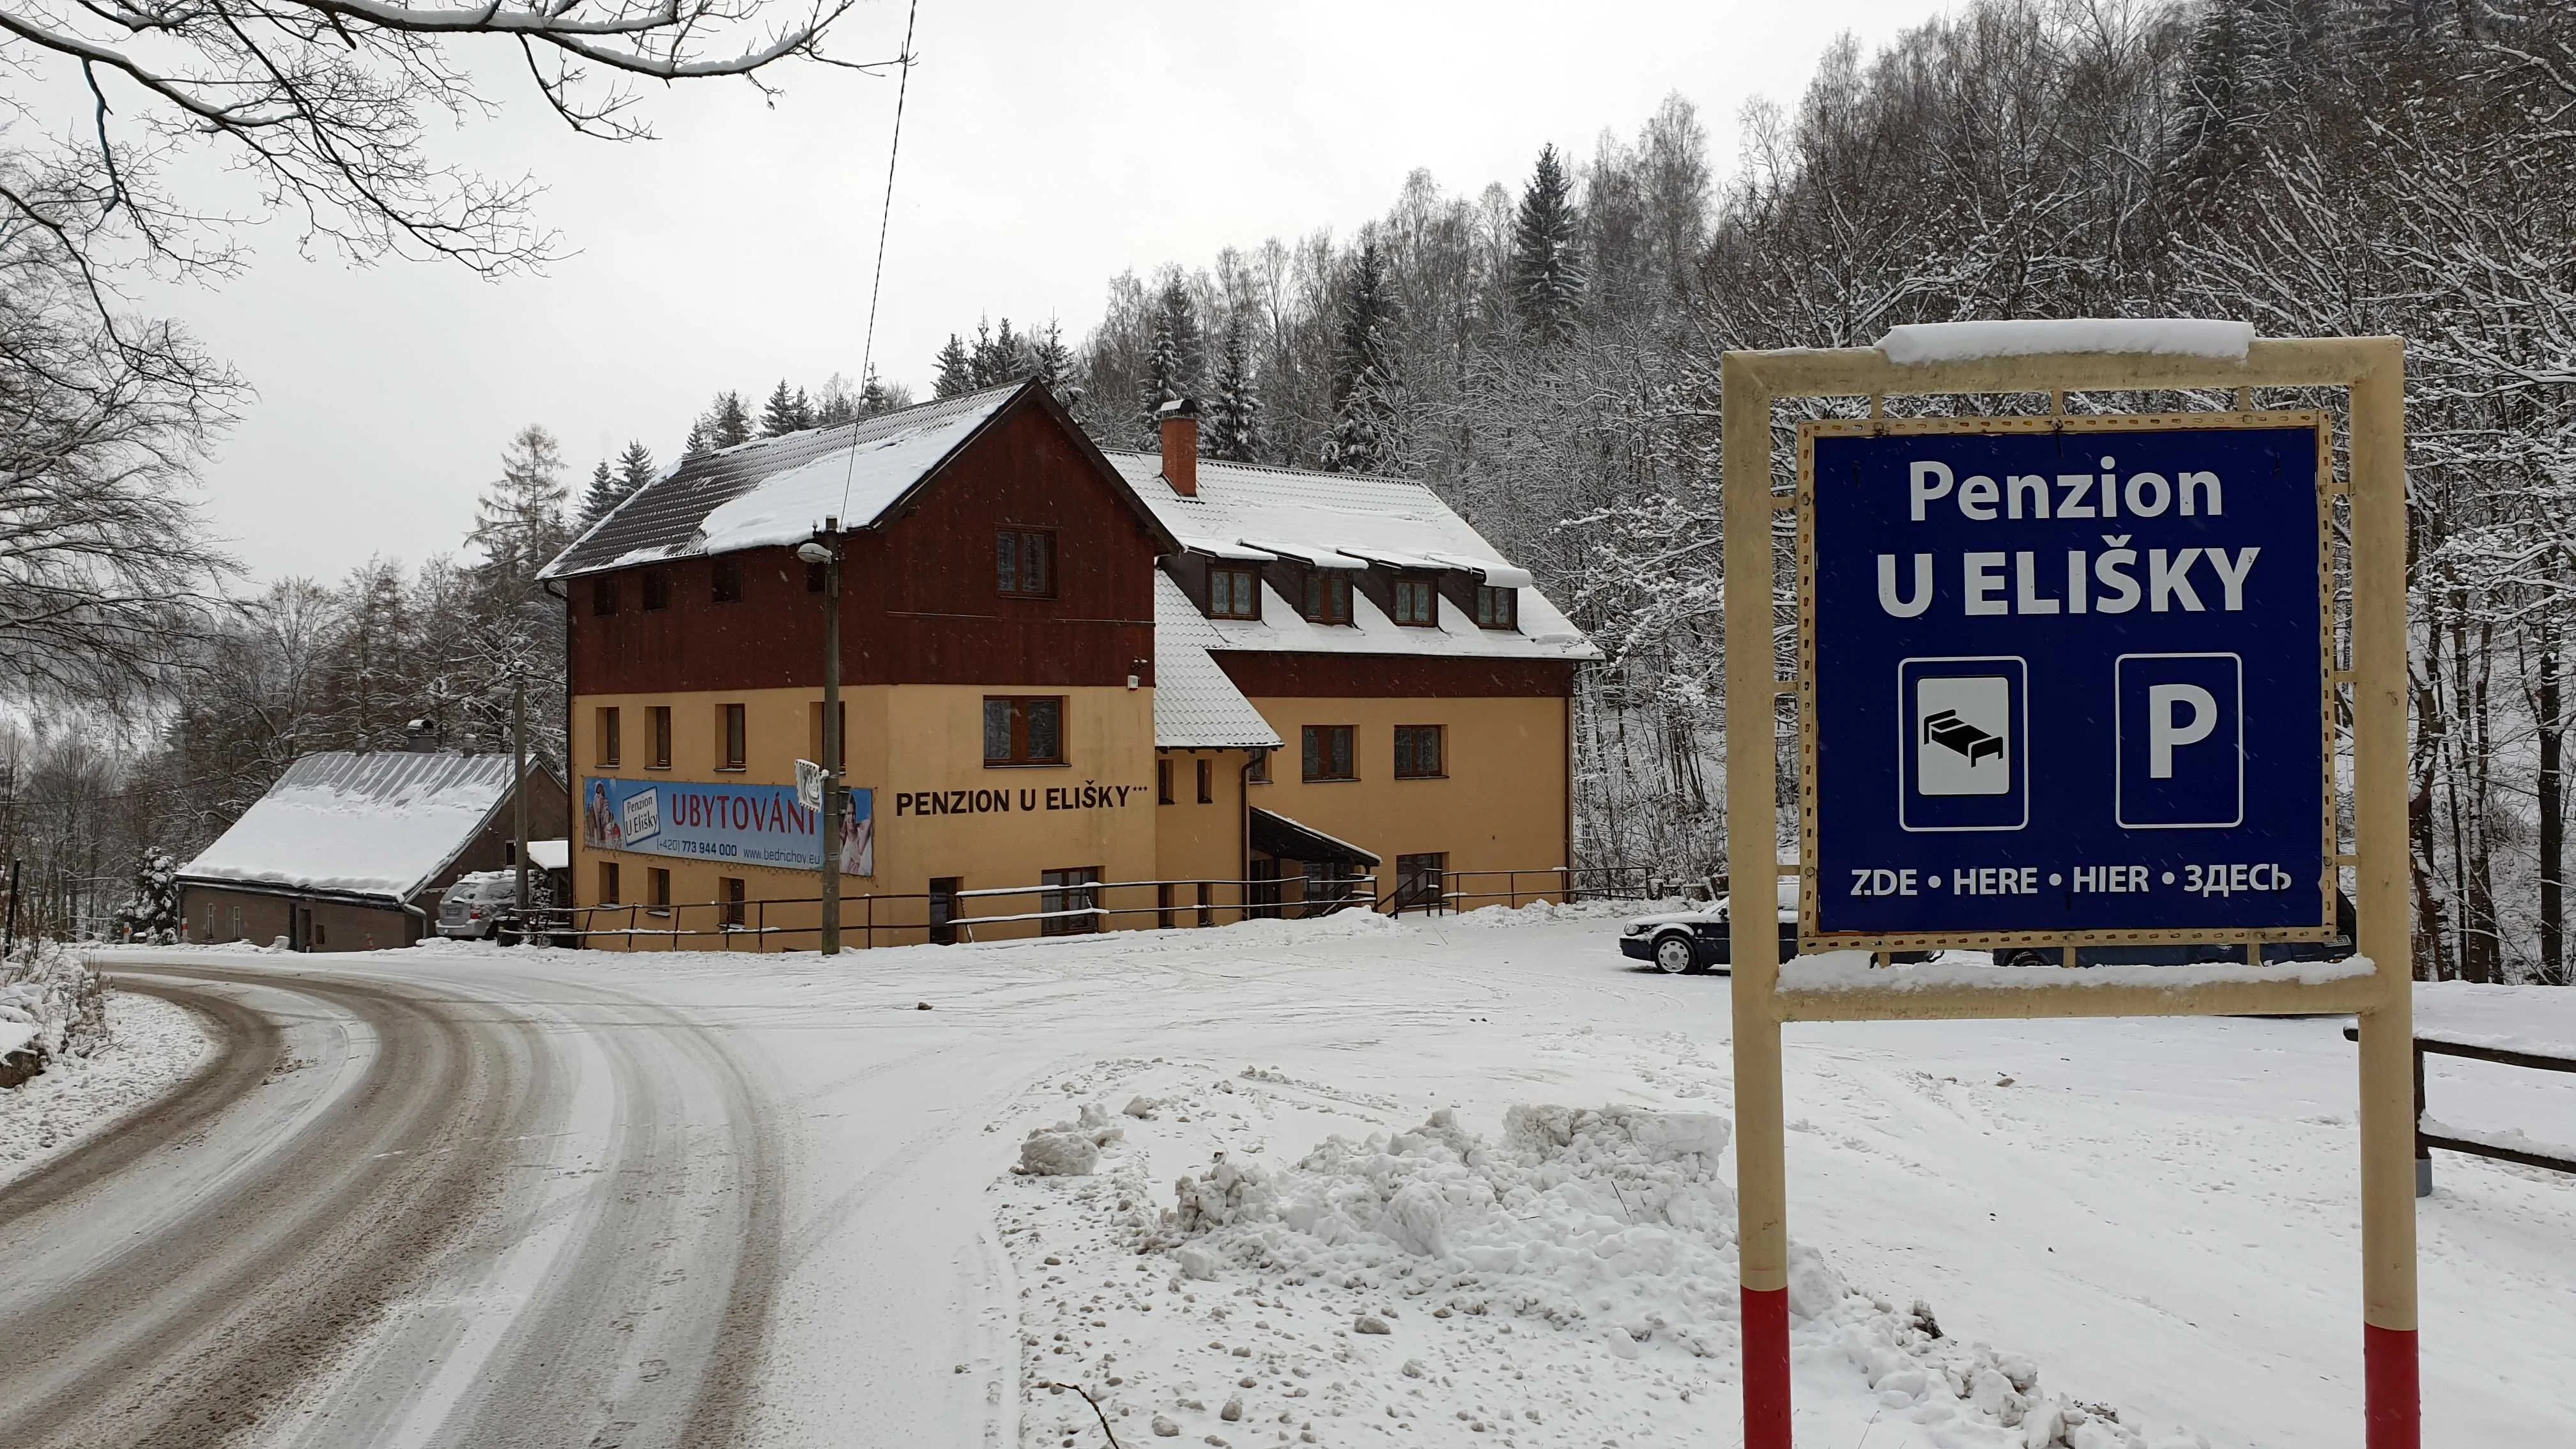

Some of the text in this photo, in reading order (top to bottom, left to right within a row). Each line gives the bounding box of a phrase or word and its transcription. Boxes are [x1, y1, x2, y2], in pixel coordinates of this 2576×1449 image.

[1910, 456, 2223, 522] Penzion
[1878, 534, 2262, 618] U ELIŠKY
[2149, 683, 2218, 778] P
[627, 795, 653, 814] Penzion
[896, 789, 1009, 816] PENZION
[1021, 788, 1036, 811] U
[625, 813, 659, 836] U Elišky
[682, 841, 697, 853] 773
[699, 843, 717, 854] 944
[719, 844, 737, 857] 000
[744, 847, 821, 865] www.bedrichov.eu
[1850, 862, 2292, 898] ZDE HERE HIER ЗДЕСЬ
